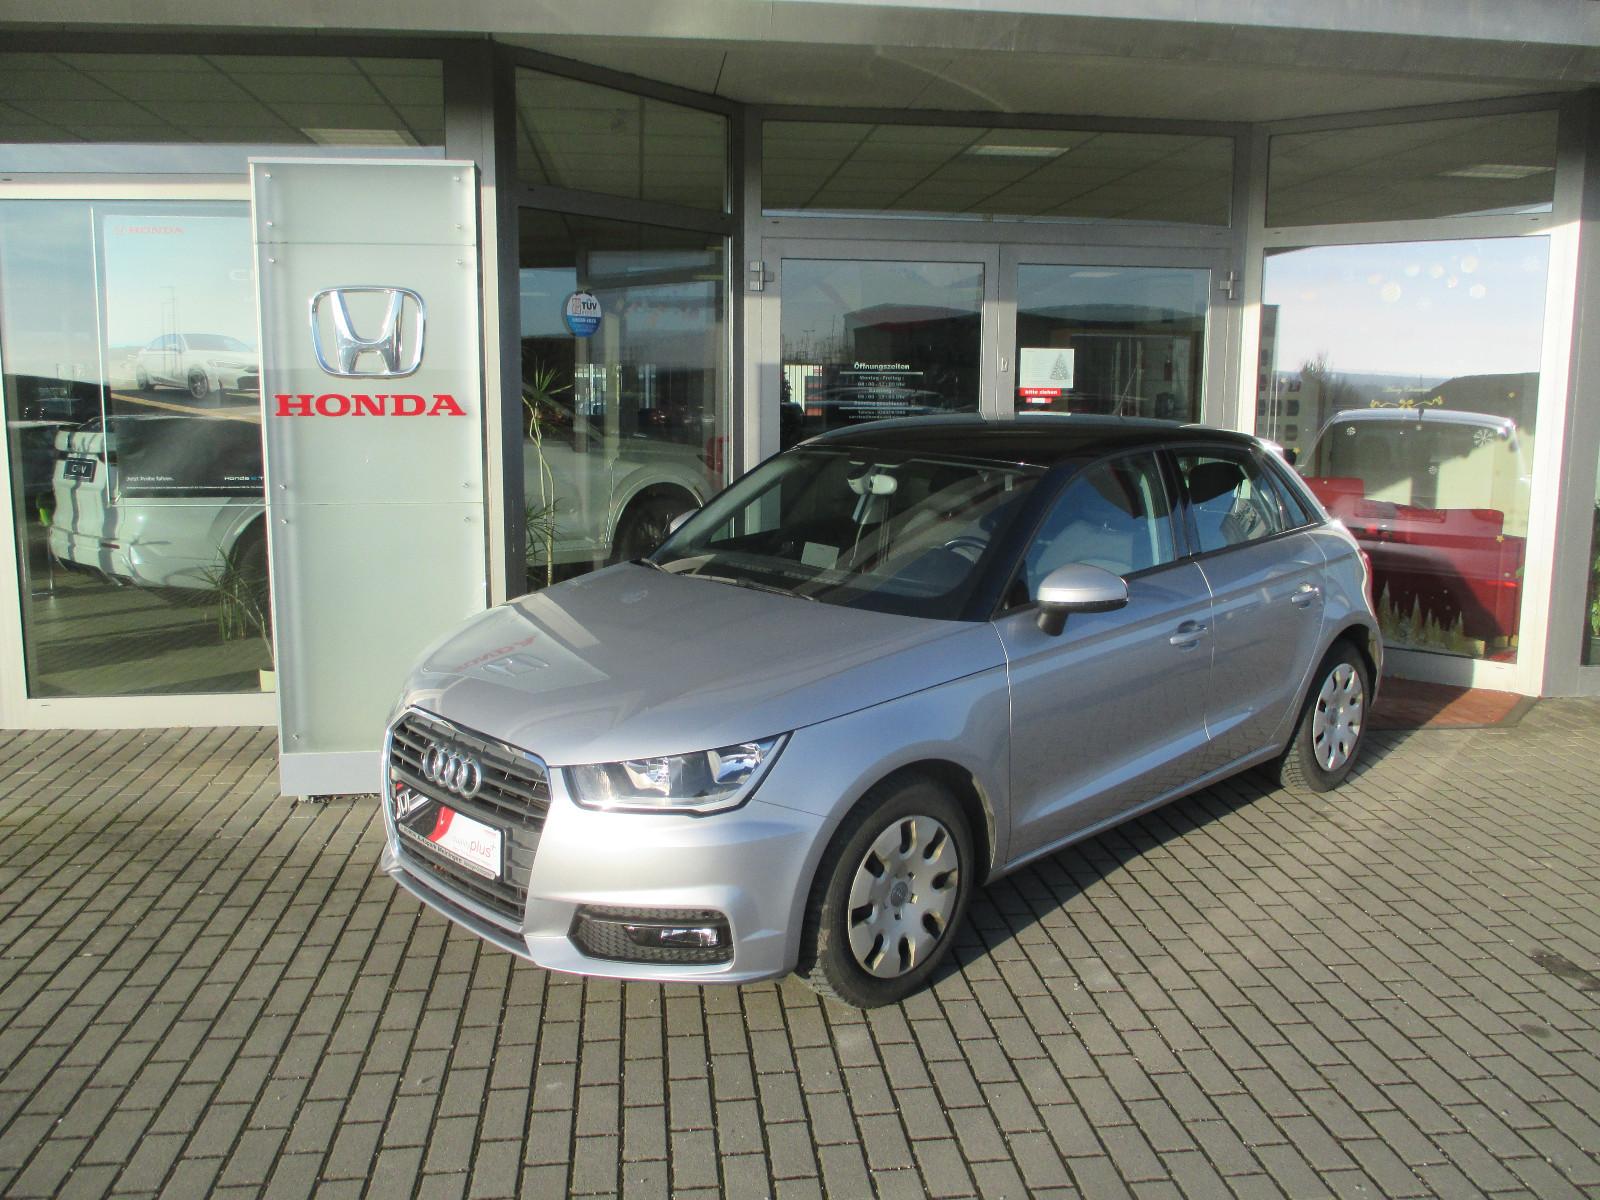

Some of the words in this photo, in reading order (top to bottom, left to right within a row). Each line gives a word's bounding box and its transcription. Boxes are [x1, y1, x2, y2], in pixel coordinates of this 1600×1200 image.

[582, 298, 597, 310] TÜV
[854, 362, 910, 370] Öffnungszeiten
[274, 393, 467, 417] HONDA
